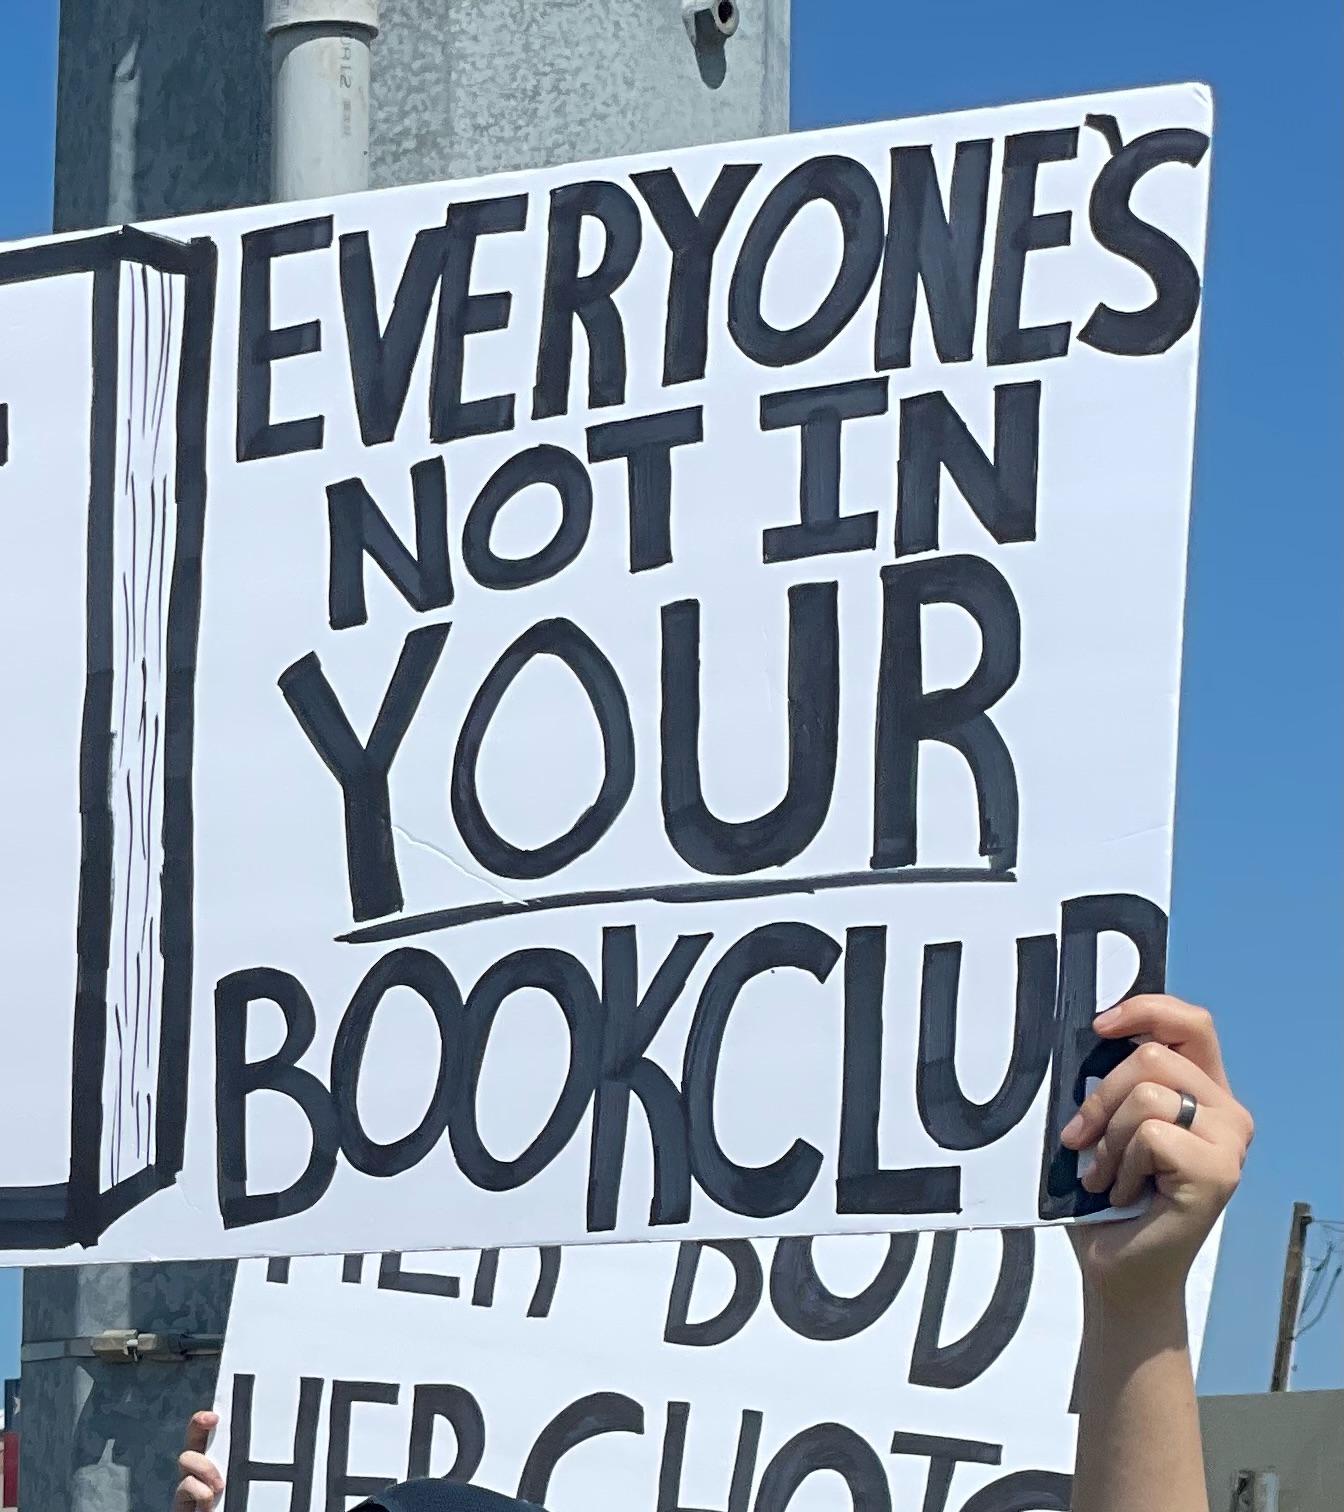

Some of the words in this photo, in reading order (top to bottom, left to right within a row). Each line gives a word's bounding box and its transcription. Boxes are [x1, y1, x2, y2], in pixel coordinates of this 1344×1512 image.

[234, 113, 1210, 461] EVERYONE'S
[324, 405, 705, 630] NOT
[760, 376, 1042, 565] IN
[277, 553, 1022, 922] YOUR
